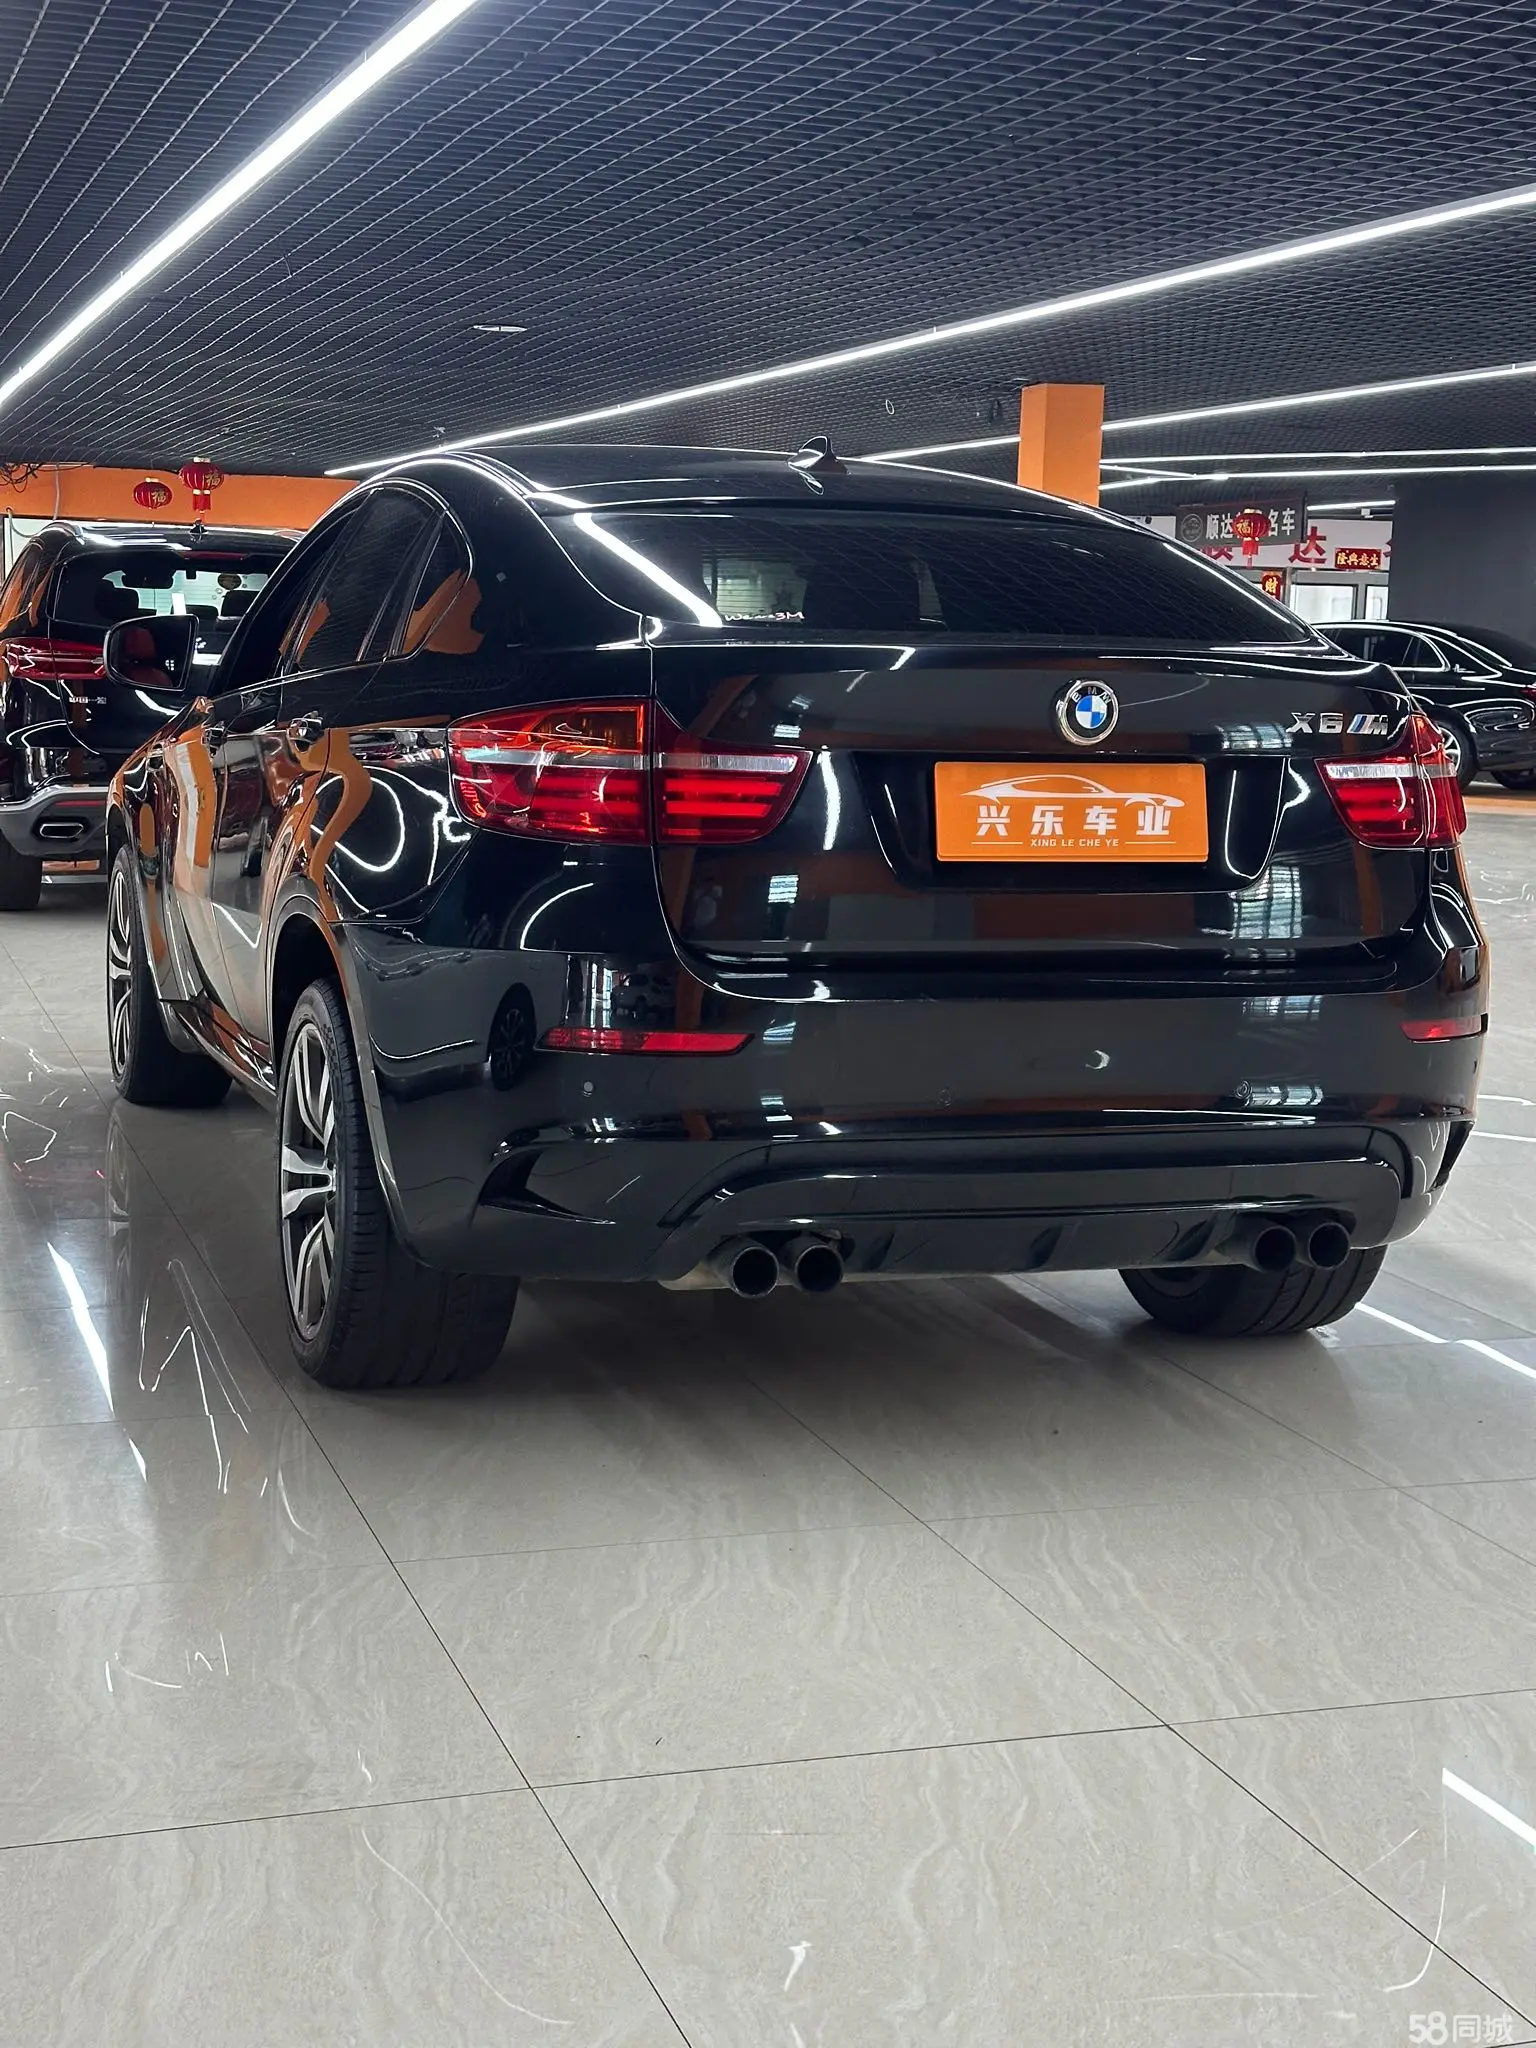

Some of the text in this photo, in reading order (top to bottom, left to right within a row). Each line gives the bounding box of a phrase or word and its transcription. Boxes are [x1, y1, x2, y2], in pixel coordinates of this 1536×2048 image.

[205, 470, 221, 486] 福
[151, 489, 167, 503] 福
[1206, 507, 1296, 540] 顺达名车
[1236, 519, 1251, 534] 福
[1071, 686, 1112, 704] BMW
[1285, 712, 1343, 734] X6
[976, 805, 1172, 836] 兴乐车业
[1031, 838, 1120, 848] XING LE CHE YE
